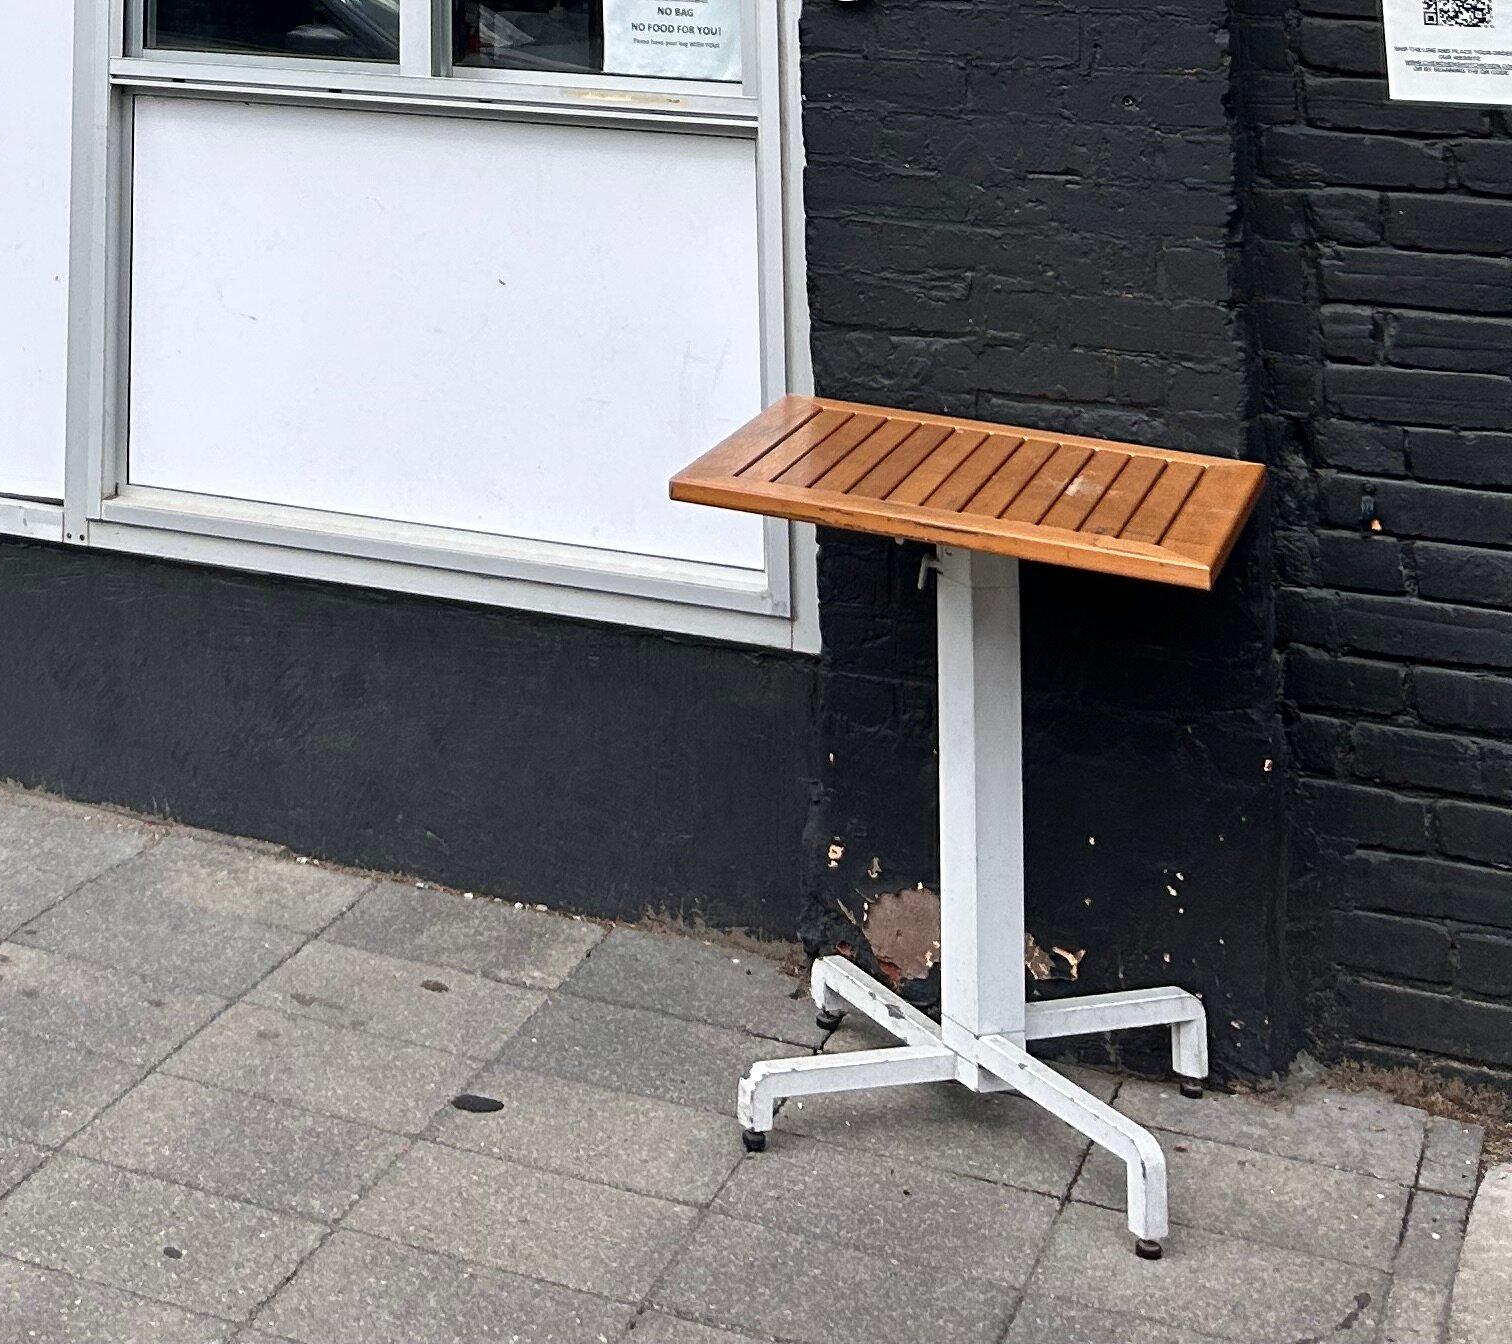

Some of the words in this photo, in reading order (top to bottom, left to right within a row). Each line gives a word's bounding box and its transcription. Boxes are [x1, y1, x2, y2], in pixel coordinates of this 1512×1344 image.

[657, 6, 673, 16] NO
[674, 7, 694, 17] BAG
[631, 22, 646, 32] NO
[647, 23, 675, 34] FOOD
[677, 25, 695, 35] FOR
[697, 26, 722, 36] YOU!
